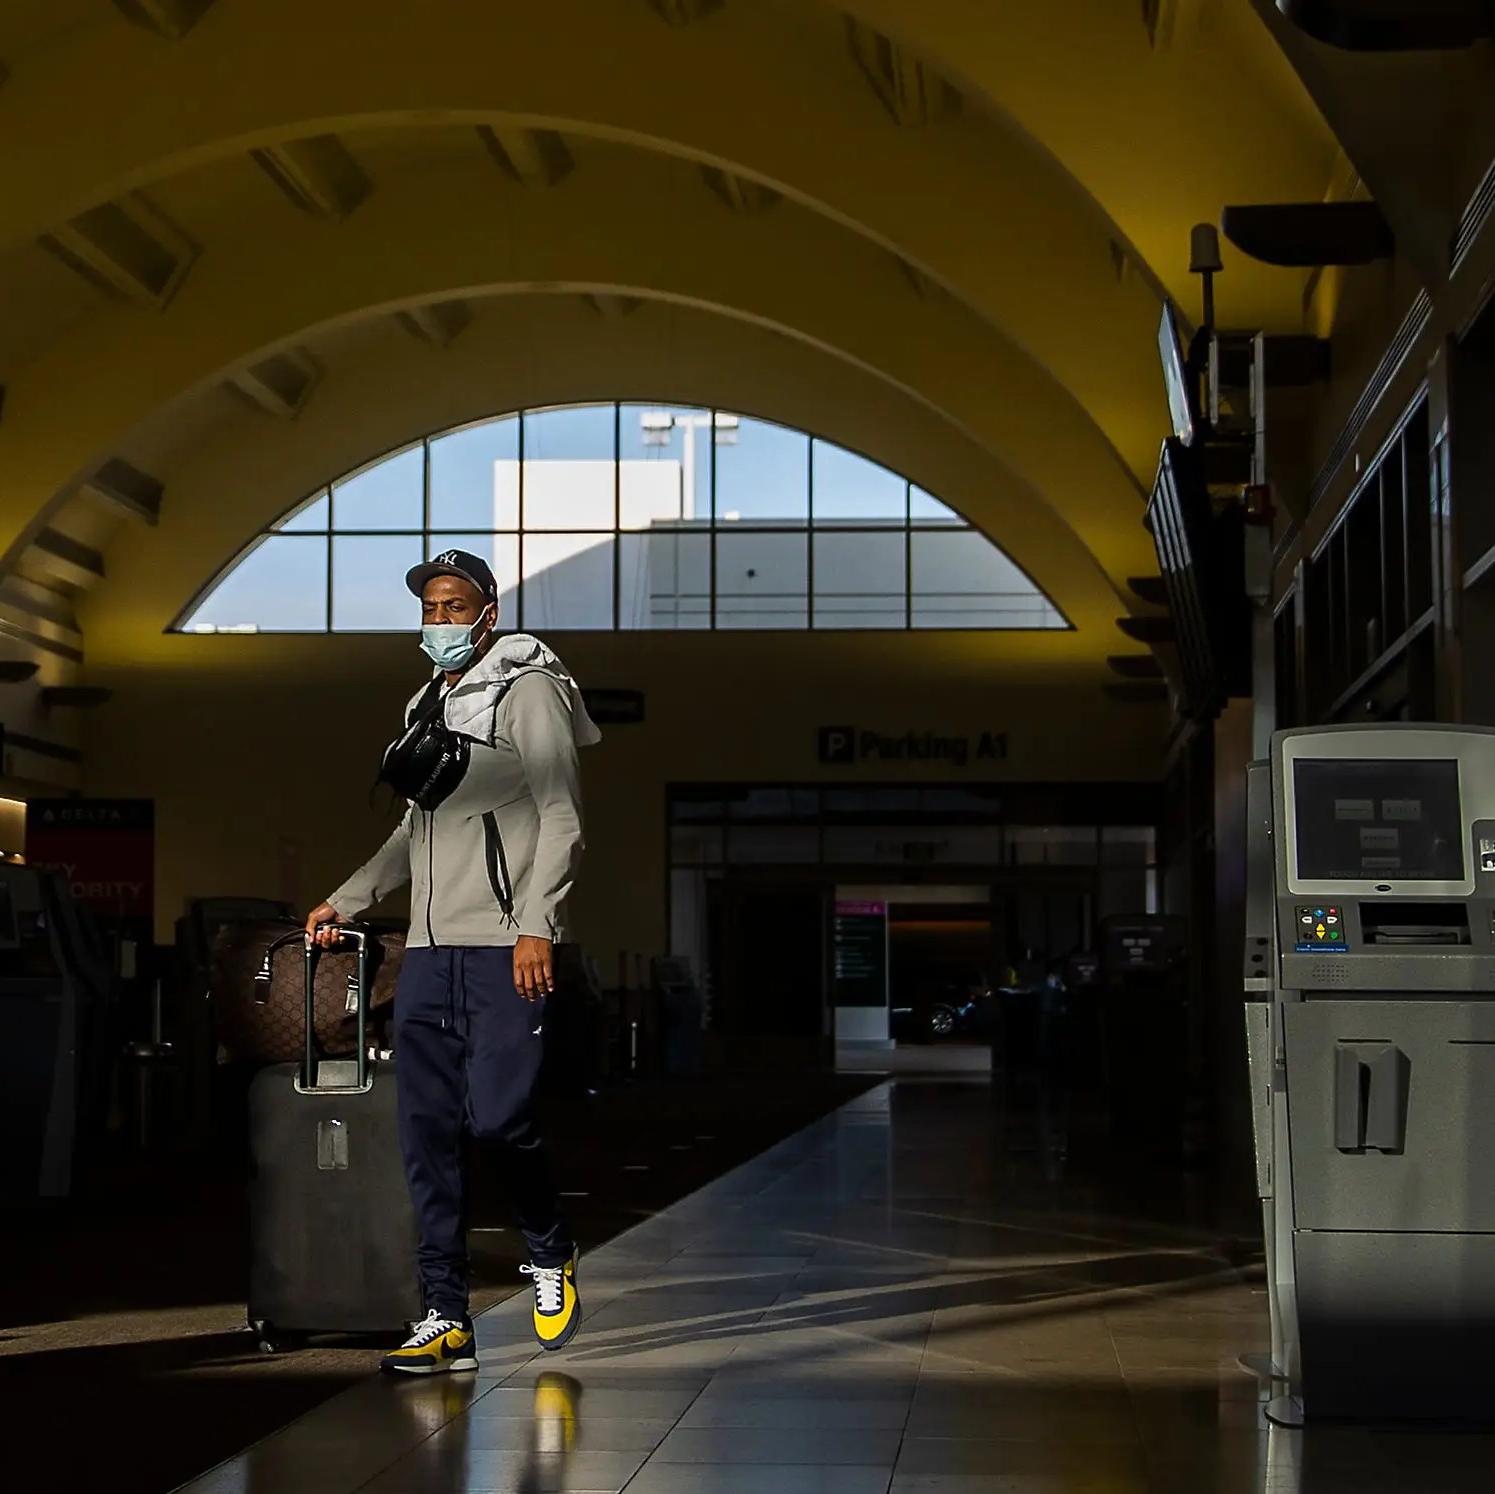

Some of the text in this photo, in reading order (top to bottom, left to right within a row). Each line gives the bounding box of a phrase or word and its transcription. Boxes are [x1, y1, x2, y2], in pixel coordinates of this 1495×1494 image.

[439, 551, 458, 566] NY
[860, 730, 968, 767] Parking
[977, 731, 1009, 760] A1
[60, 807, 122, 821] DELTA
[70, 881, 146, 899] ORITY
